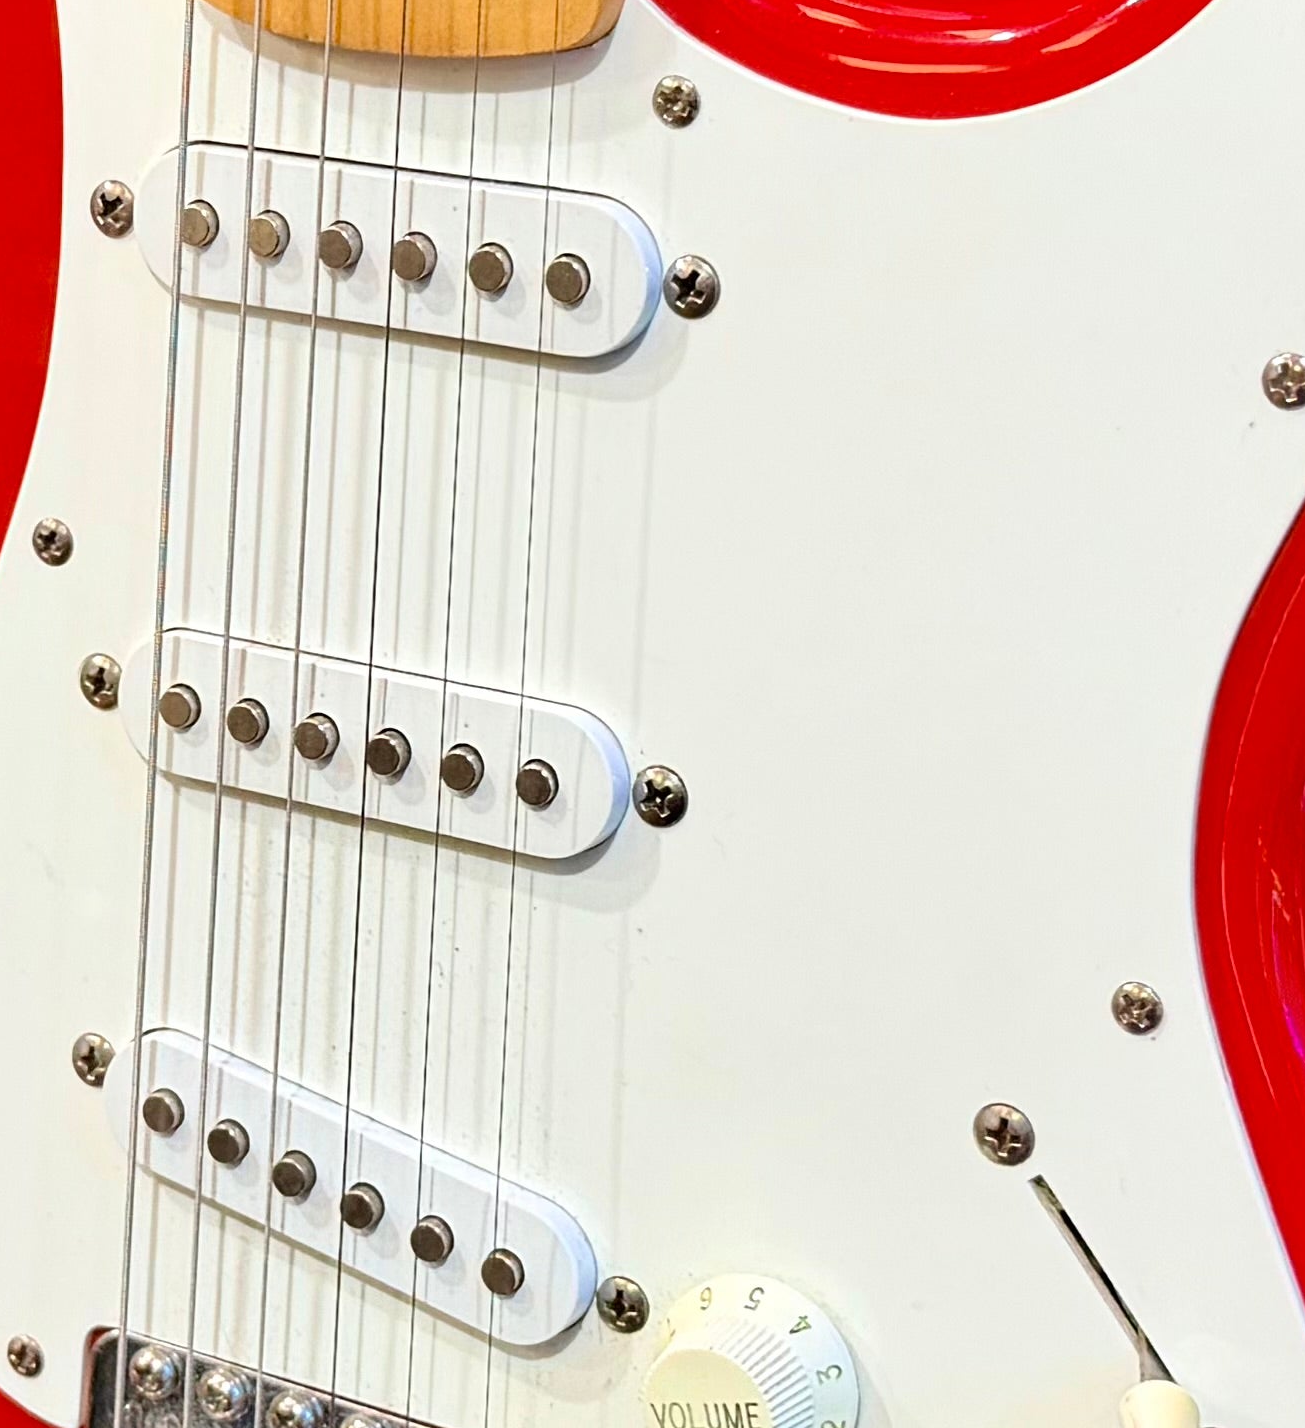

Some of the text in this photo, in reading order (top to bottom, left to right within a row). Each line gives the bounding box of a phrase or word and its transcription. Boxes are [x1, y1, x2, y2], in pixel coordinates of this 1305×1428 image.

[743, 1286, 765, 1311] 5
[789, 1314, 812, 1335] 4
[815, 1363, 843, 1385] 3
